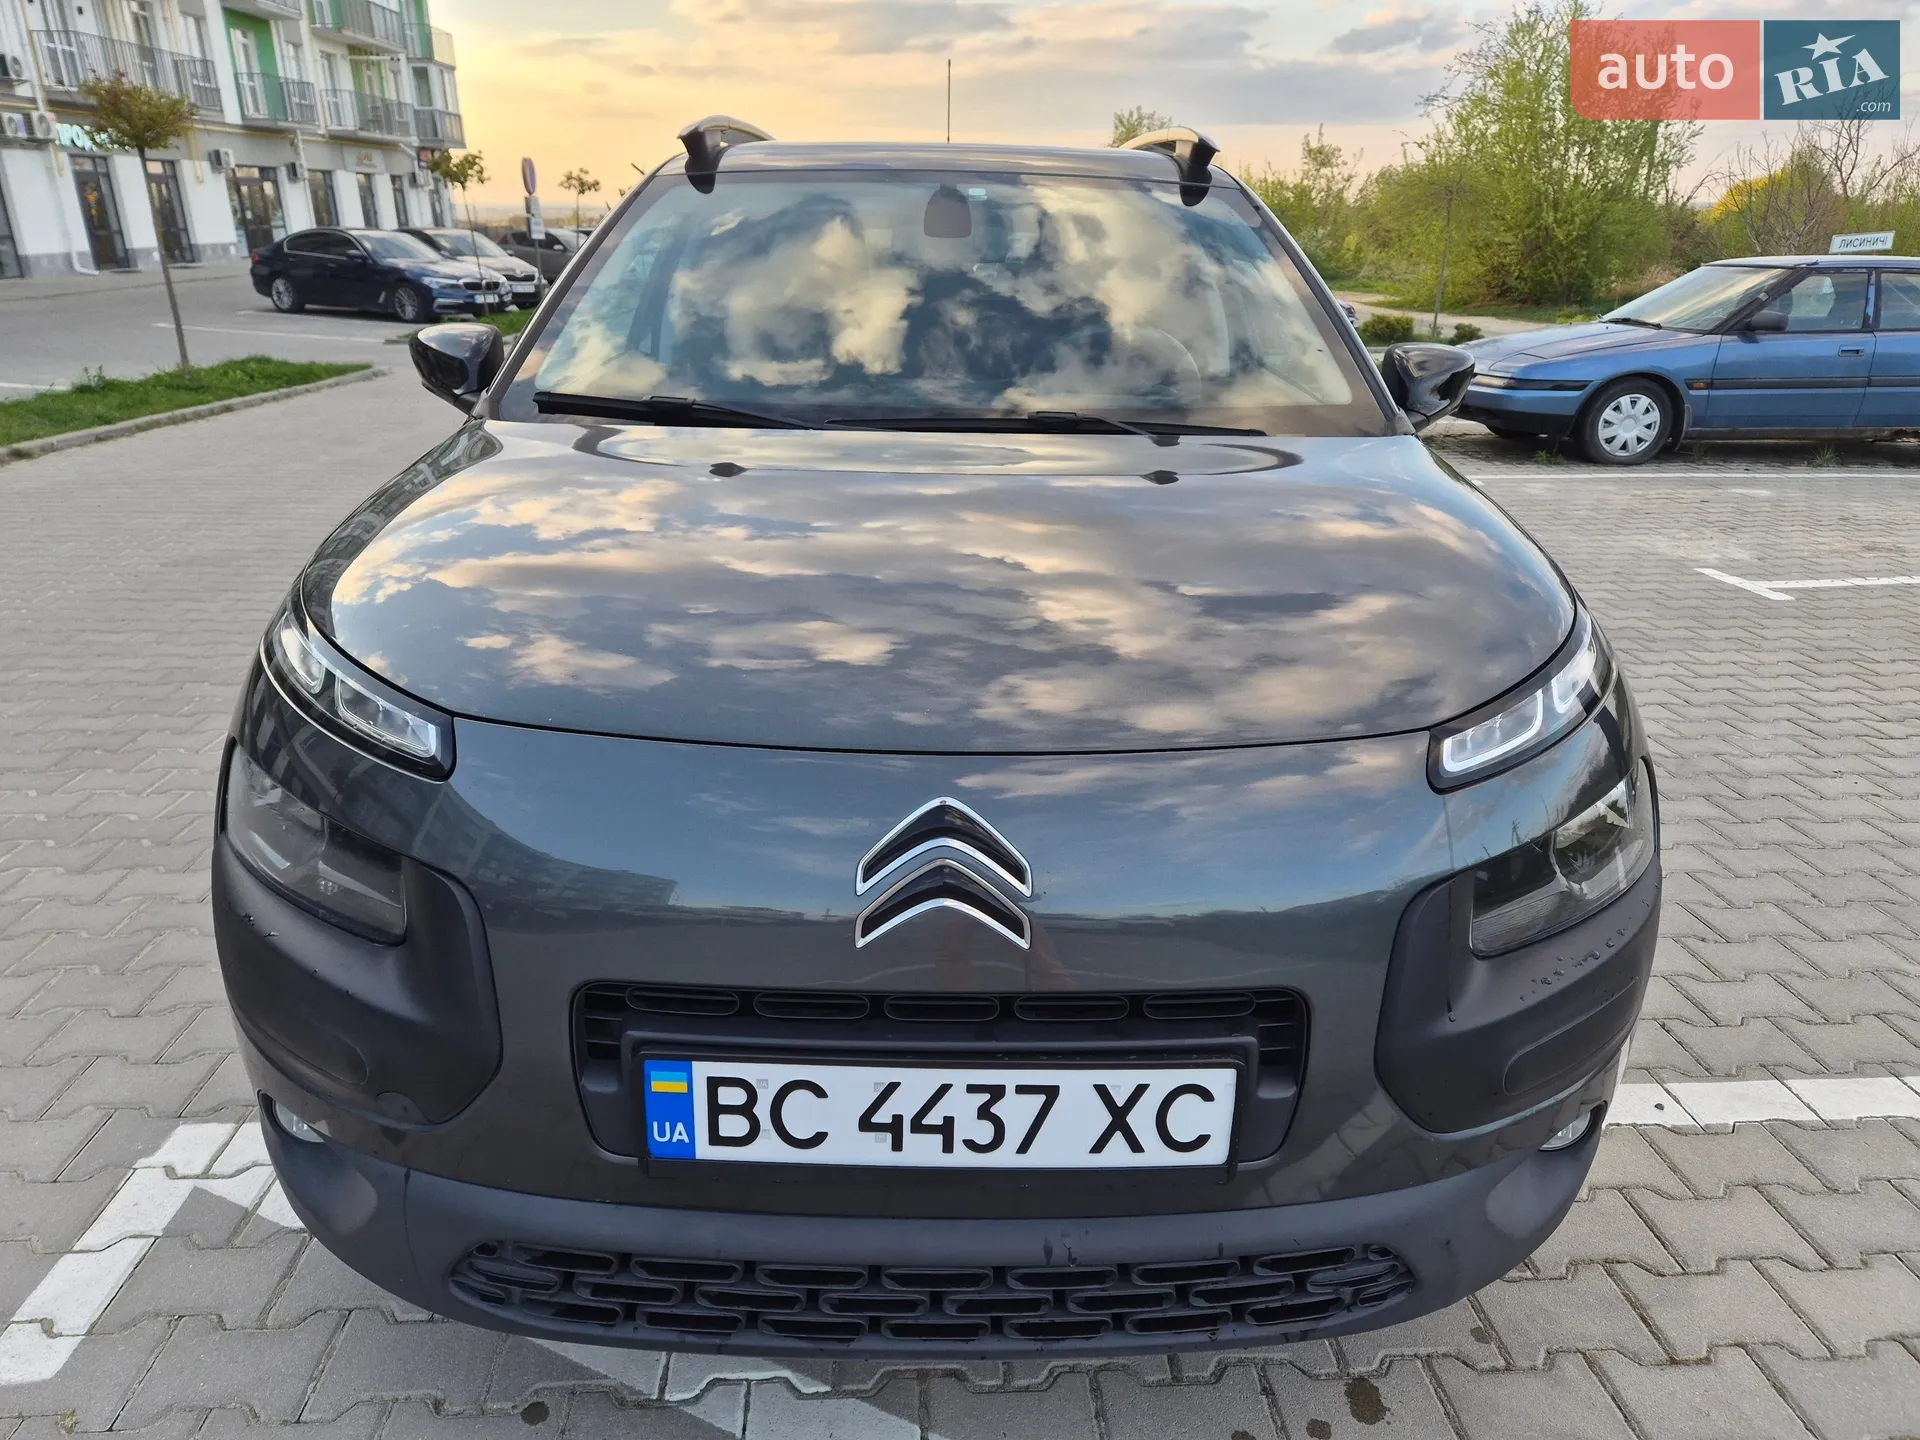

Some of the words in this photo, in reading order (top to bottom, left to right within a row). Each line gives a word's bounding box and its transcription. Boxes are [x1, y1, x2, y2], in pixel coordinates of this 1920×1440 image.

[1838, 236, 1888, 249] ЛИСИНИЧІ
[706, 1076, 829, 1149] BC
[858, 1081, 1060, 1154] 4437
[1088, 1083, 1216, 1155] XC
[653, 1121, 690, 1143] UA
